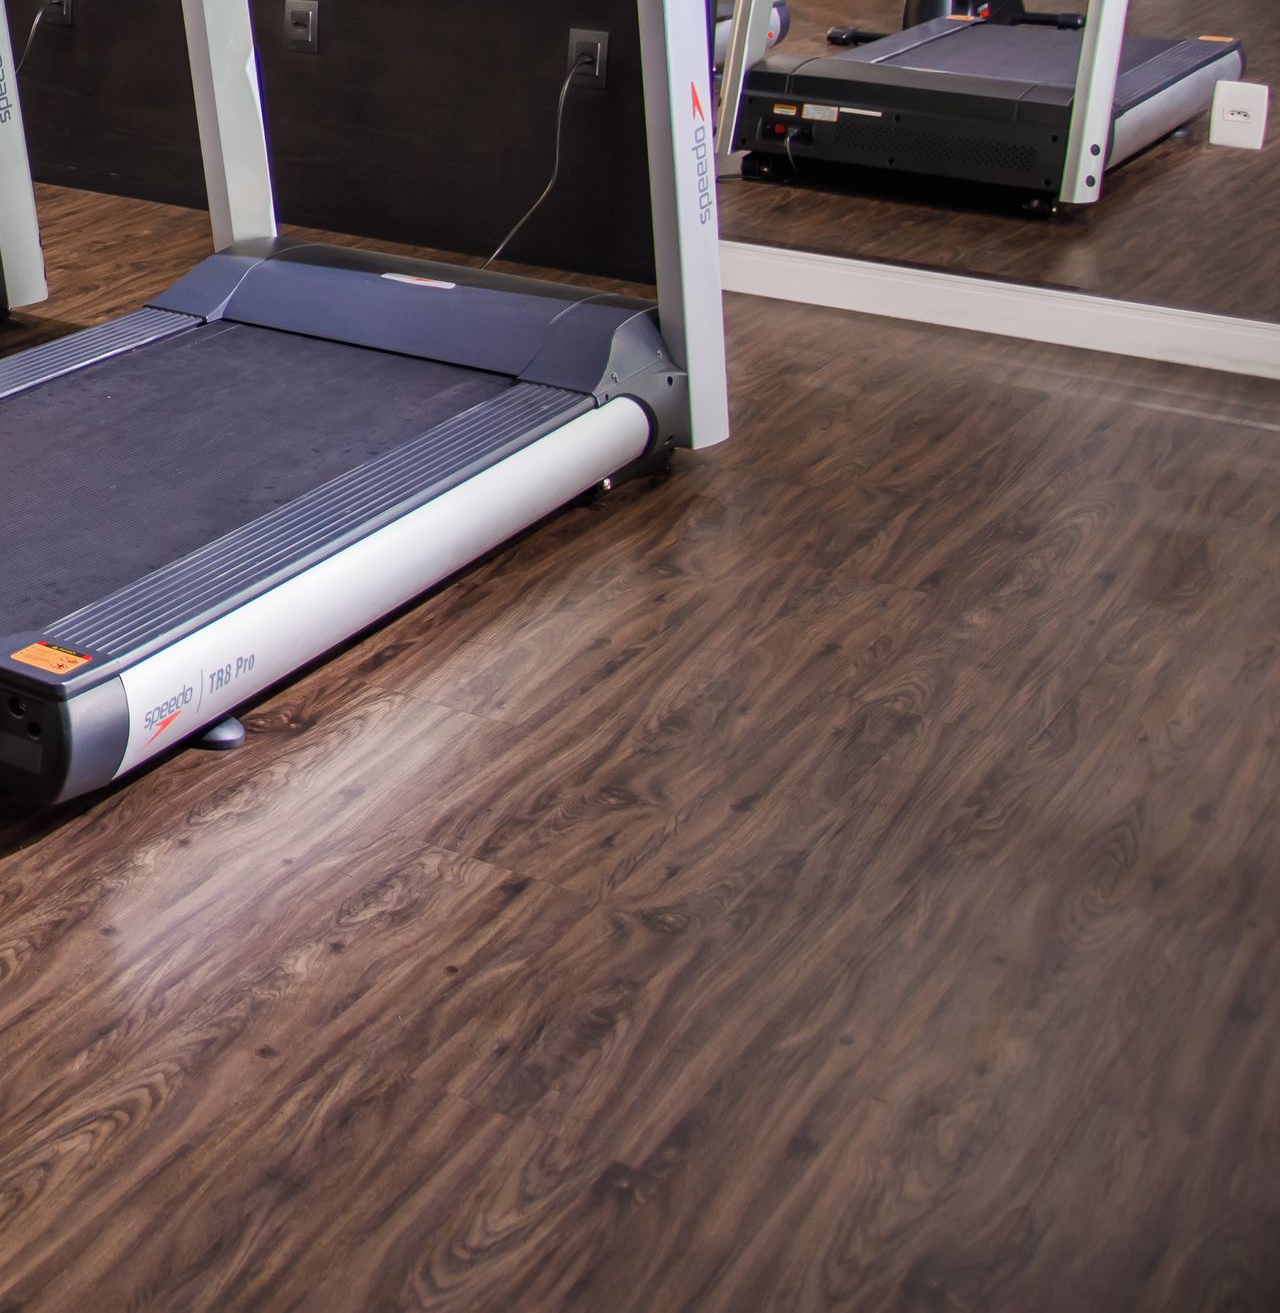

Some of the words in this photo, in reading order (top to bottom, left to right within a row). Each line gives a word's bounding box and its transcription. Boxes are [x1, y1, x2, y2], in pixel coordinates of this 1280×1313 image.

[691, 125, 712, 225] speedo
[144, 684, 193, 730] speedo
[209, 663, 231, 695] TR8
[235, 653, 255, 680] Pro
